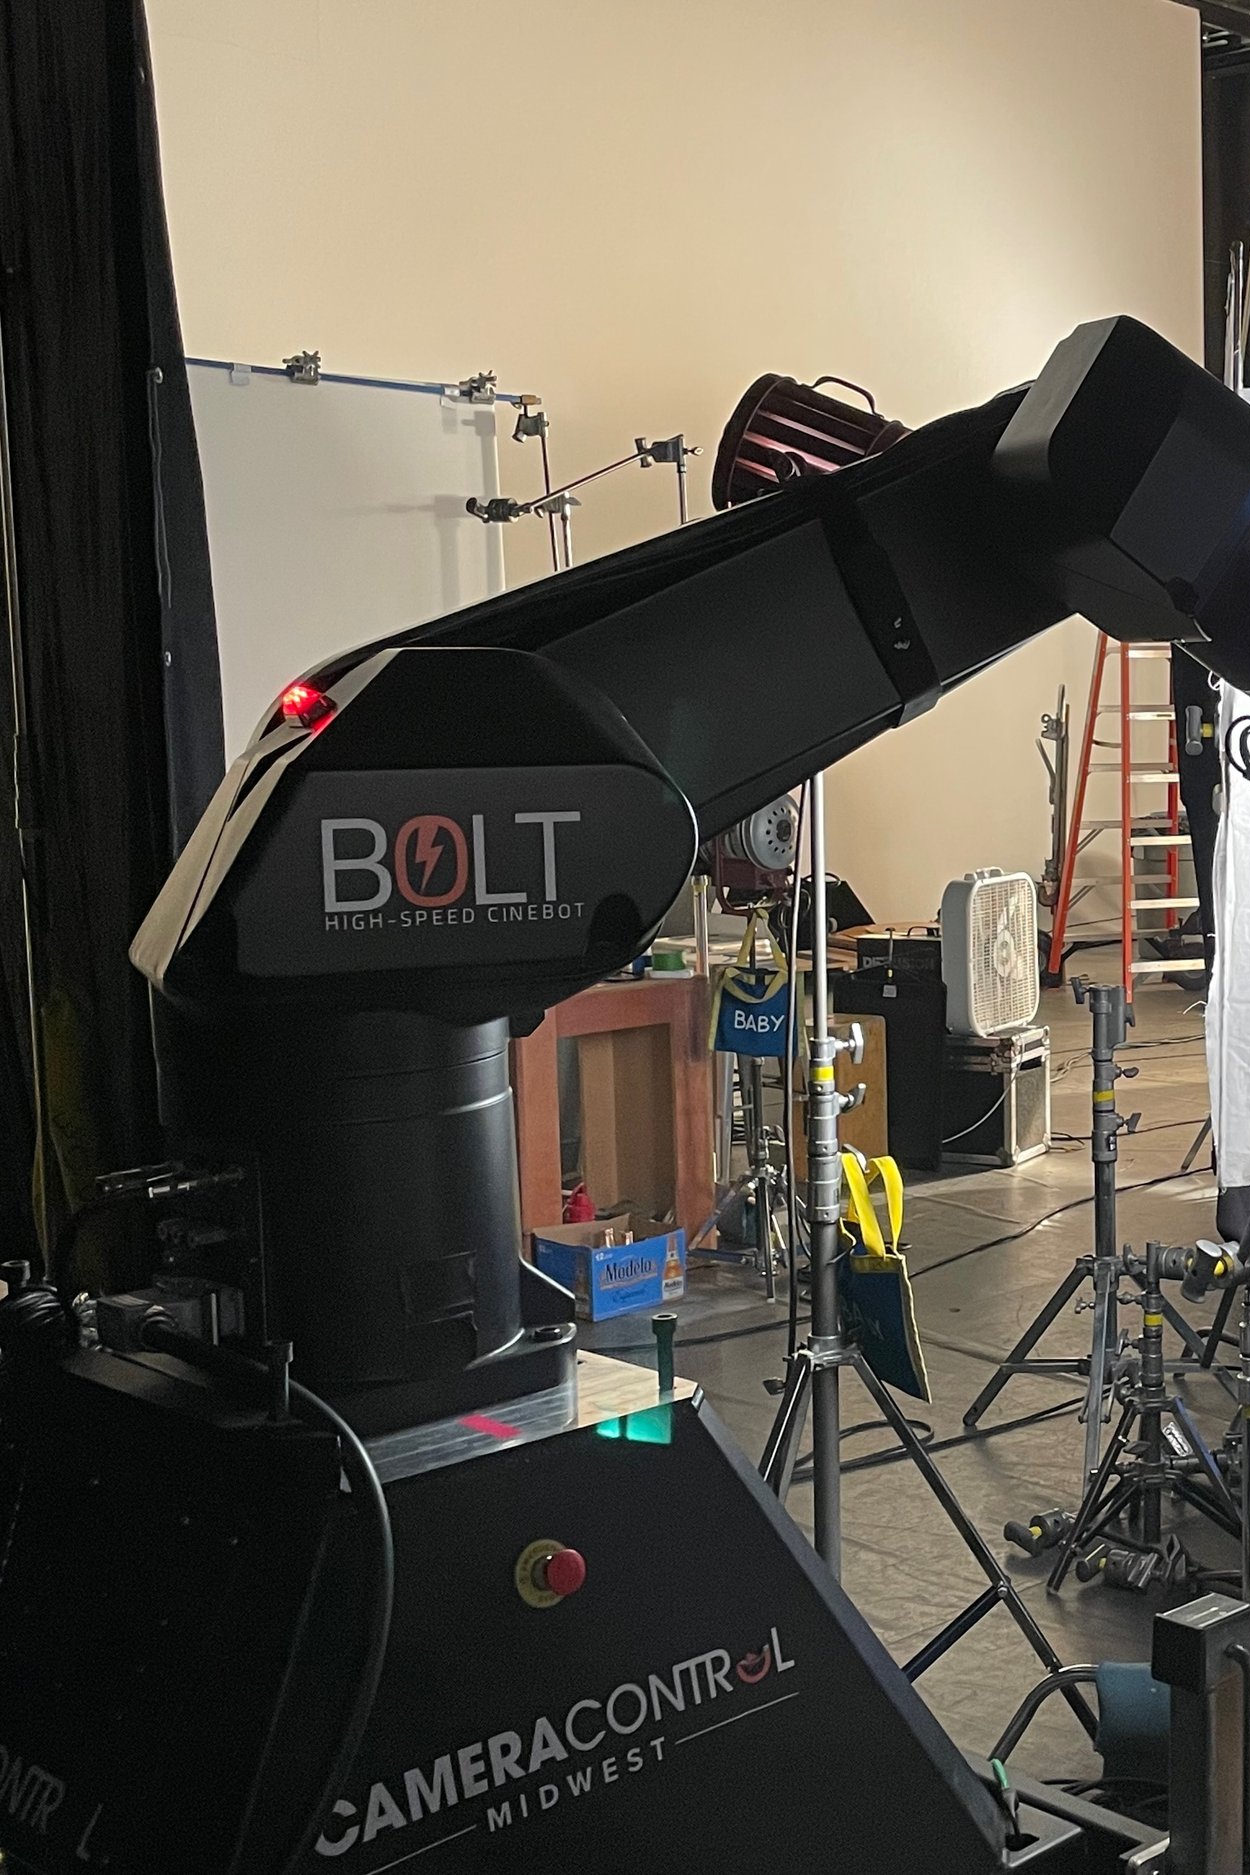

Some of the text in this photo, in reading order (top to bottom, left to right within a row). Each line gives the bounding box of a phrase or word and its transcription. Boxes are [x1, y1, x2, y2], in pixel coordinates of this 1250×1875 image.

[321, 811, 581, 912] BOLT
[325, 903, 585, 931] HIGH-SPEED CINEBOT
[734, 1010, 785, 1033] BABY
[605, 1257, 652, 1283] Modelo
[486, 1736, 667, 1833] MIDWEST
